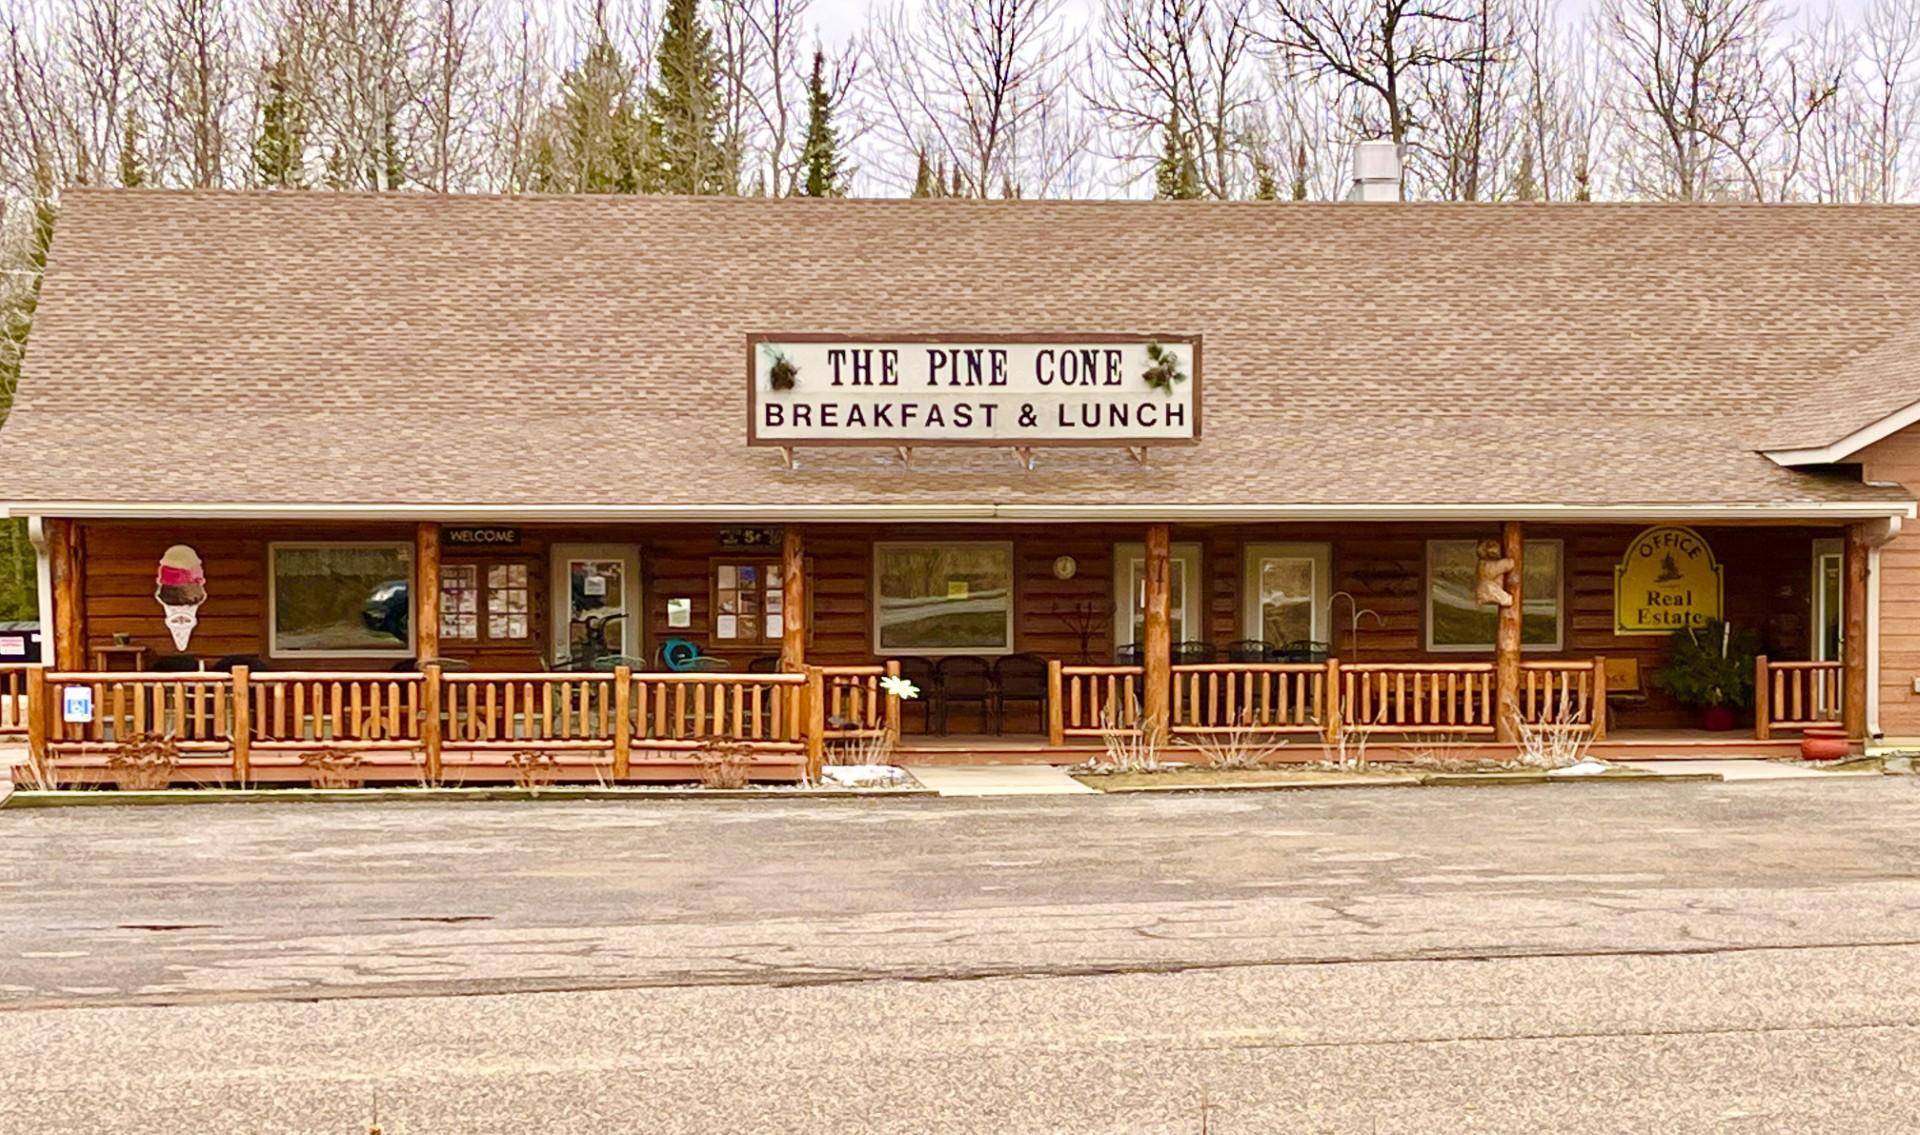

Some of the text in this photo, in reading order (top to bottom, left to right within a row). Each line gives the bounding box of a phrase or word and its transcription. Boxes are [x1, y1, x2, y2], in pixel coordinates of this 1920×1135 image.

[828, 349, 1123, 387] THE PINE CONE
[764, 403, 1185, 428] BREAKFAST & LUNCH
[450, 529, 515, 543] WELCOME
[1639, 532, 1702, 560] OFFICE
[1647, 590, 1693, 607] Real
[1637, 608, 1703, 625] Estate
